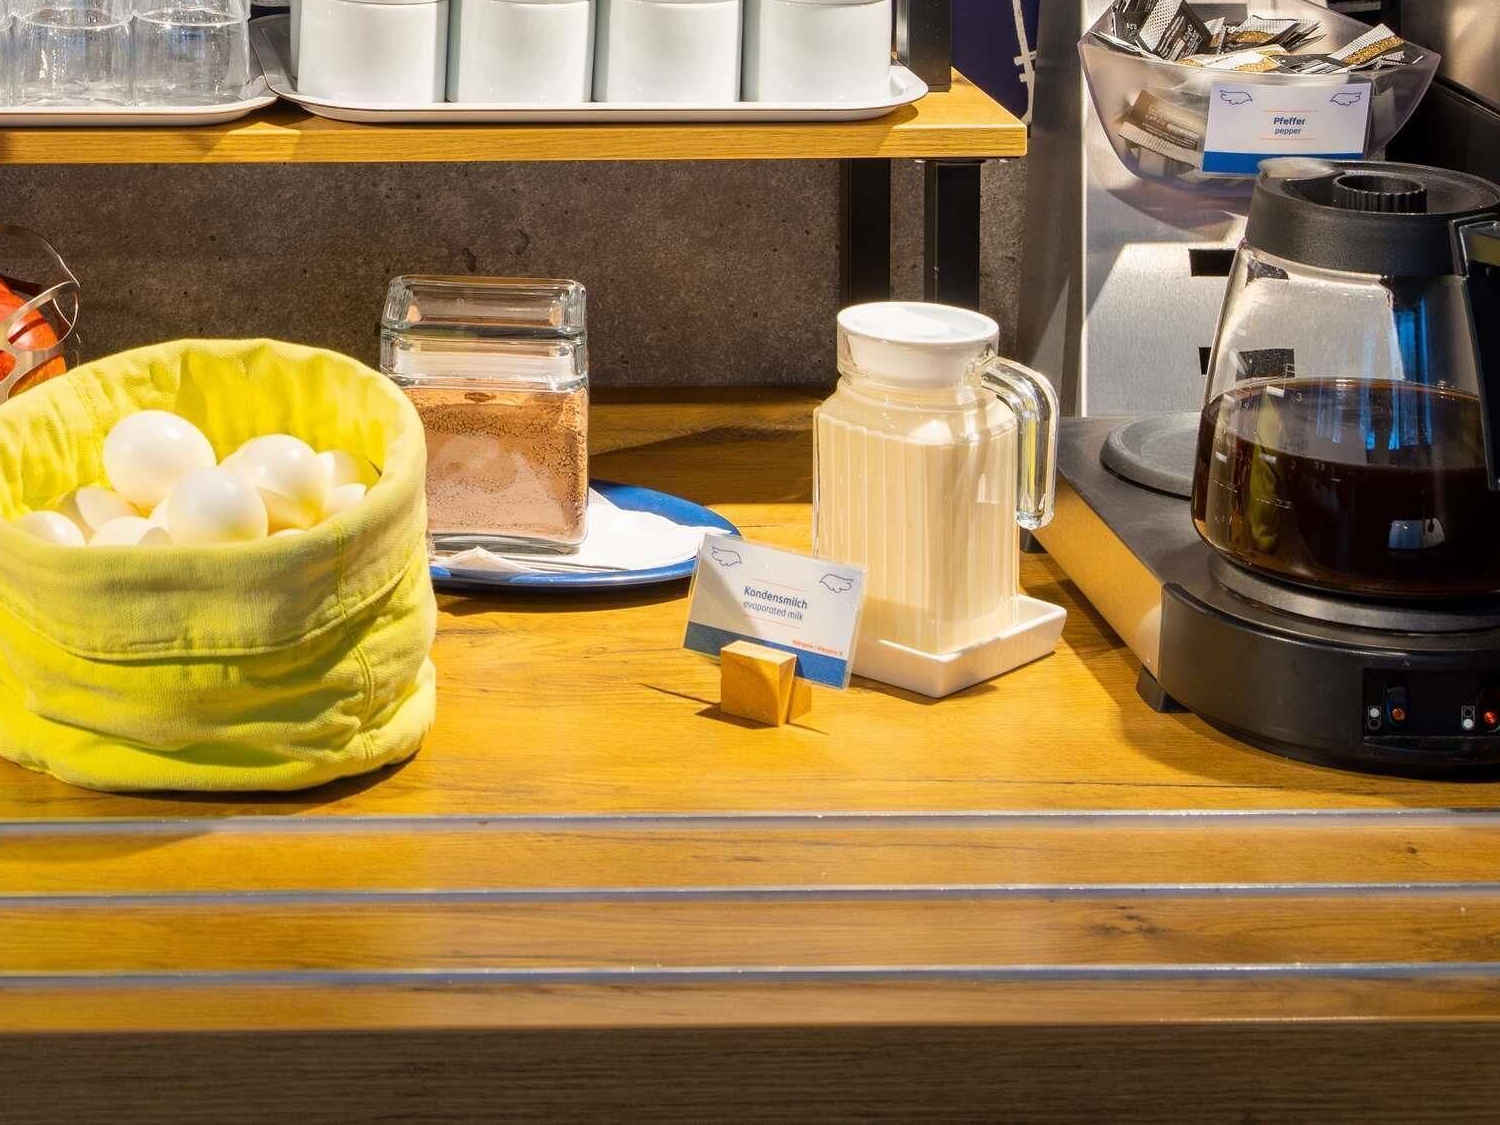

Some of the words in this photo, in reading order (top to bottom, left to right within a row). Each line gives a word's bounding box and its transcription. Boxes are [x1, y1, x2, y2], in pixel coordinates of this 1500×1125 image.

[1273, 117, 1306, 126] Pfeffer
[1274, 127, 1302, 135] pepper
[743, 586, 808, 609] Kondensmilch
[743, 601, 787, 616] evaporated
[787, 611, 805, 620] milk
